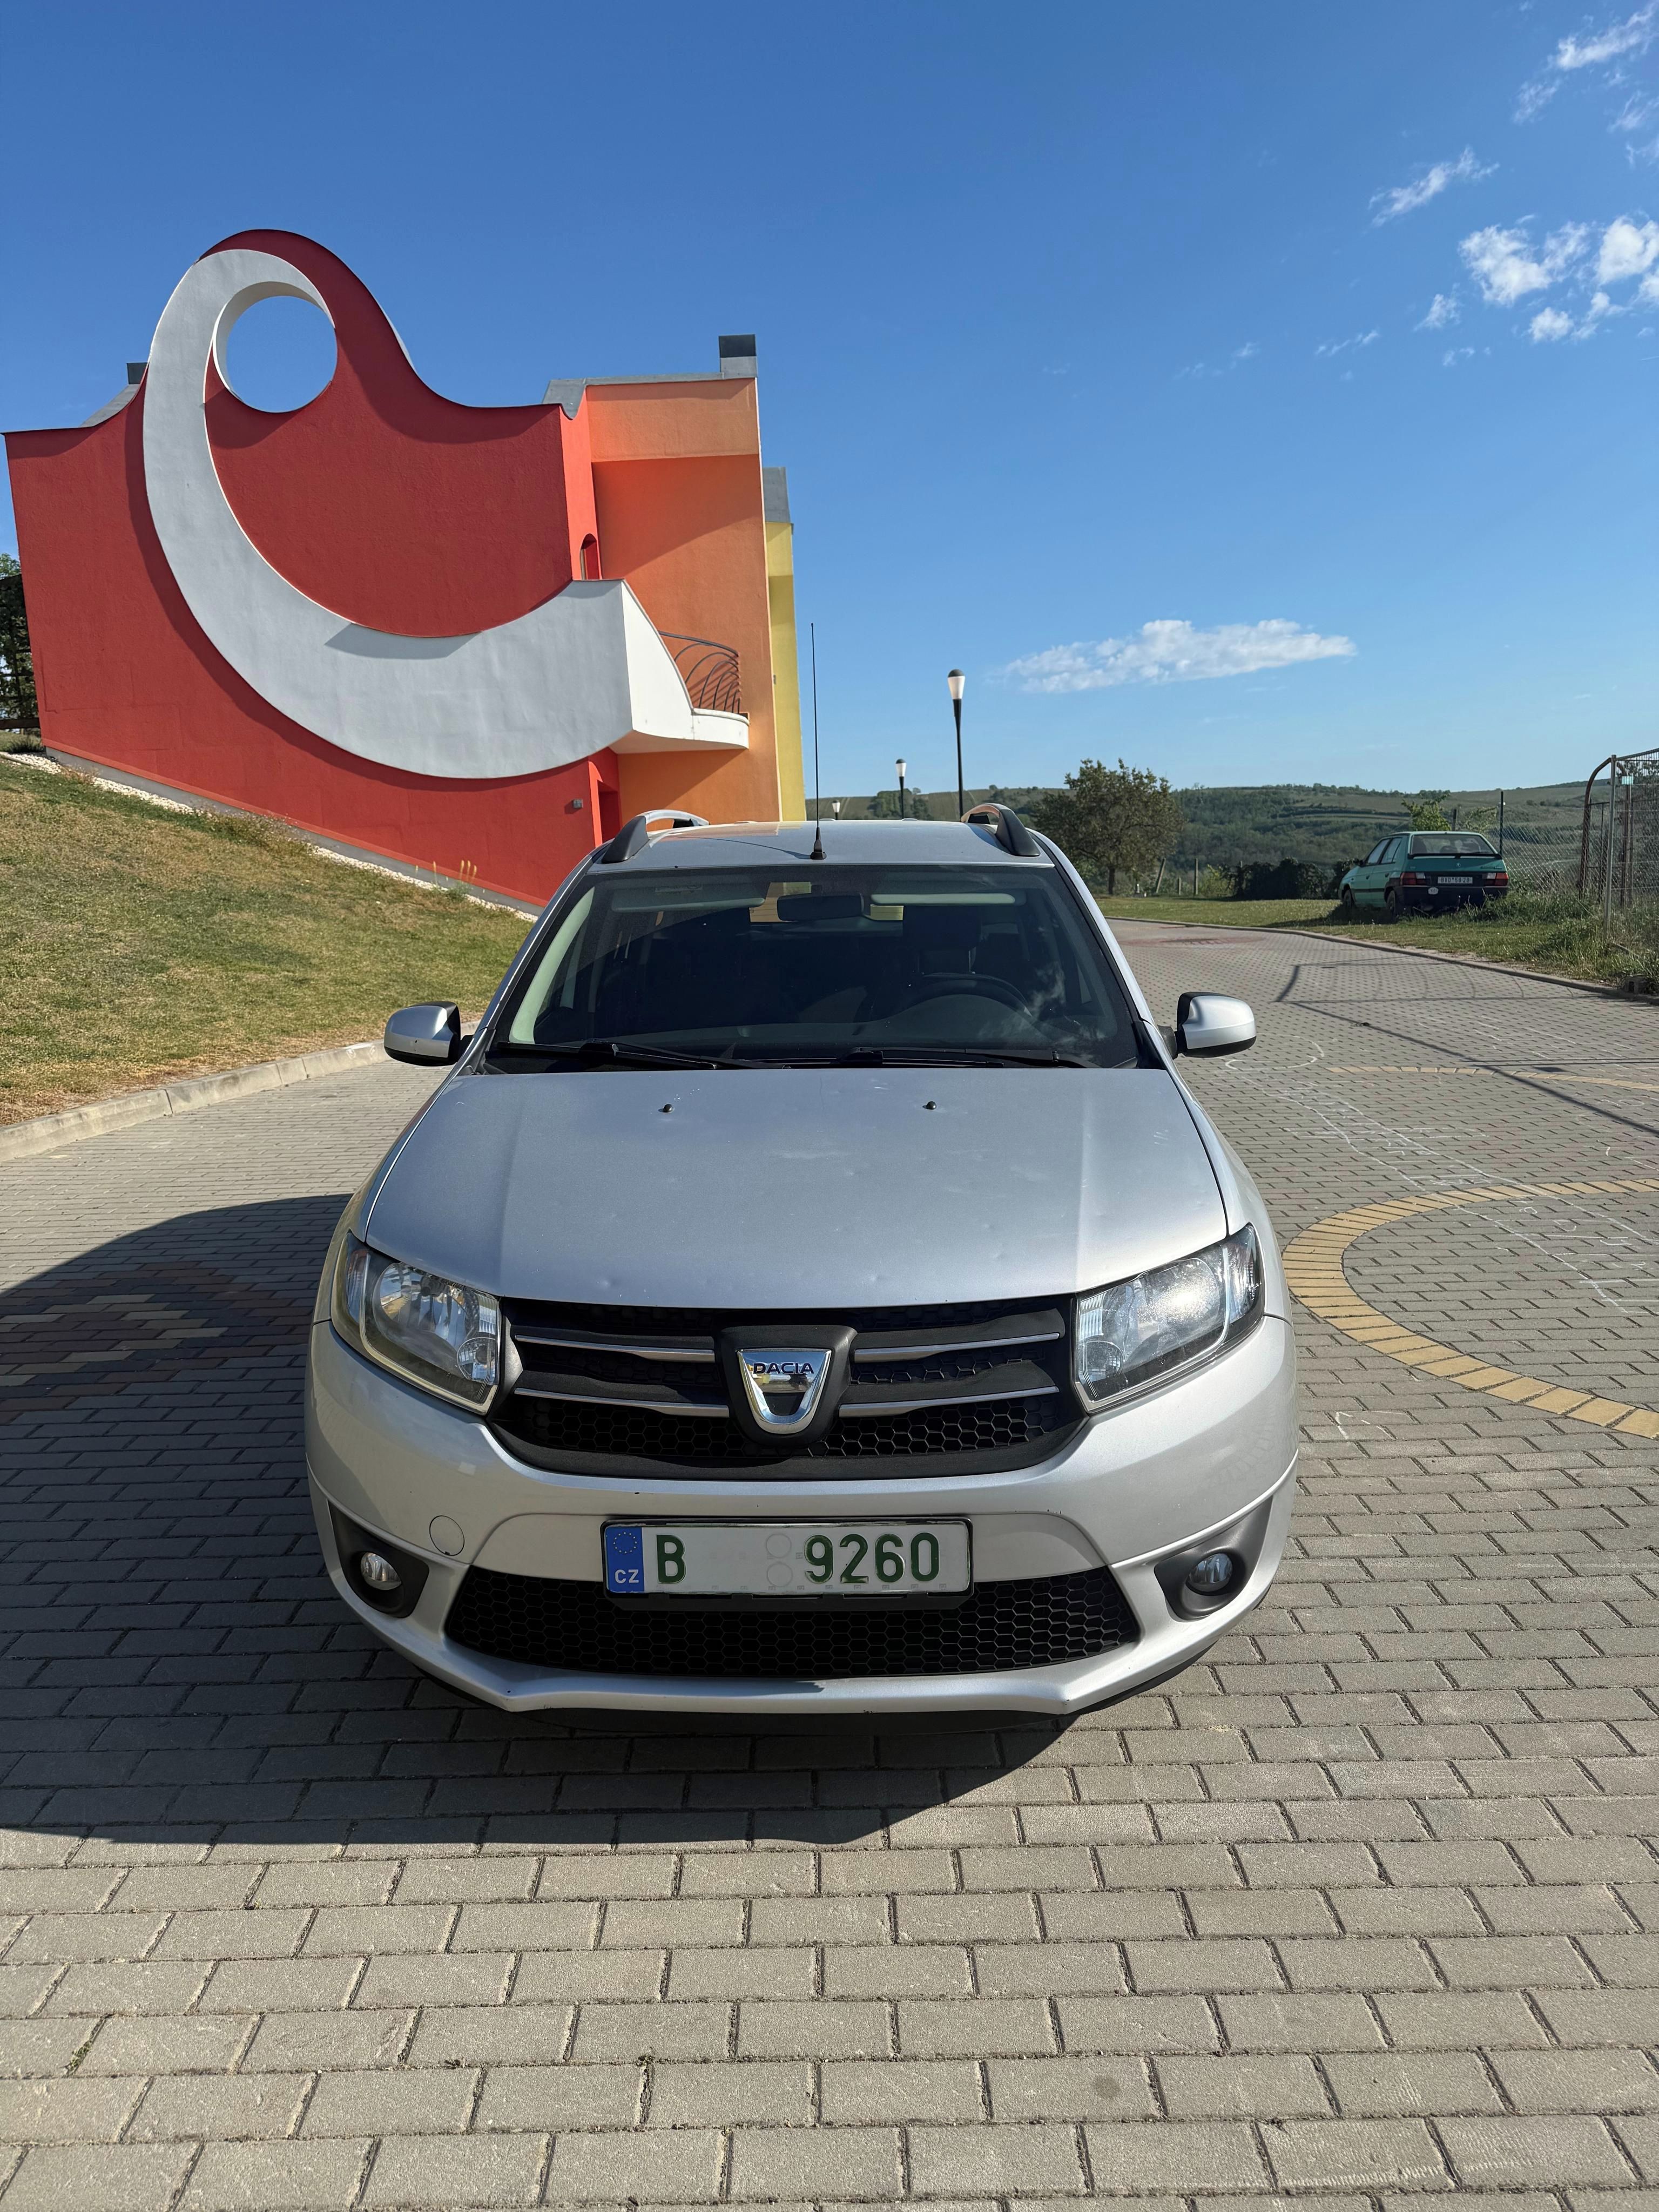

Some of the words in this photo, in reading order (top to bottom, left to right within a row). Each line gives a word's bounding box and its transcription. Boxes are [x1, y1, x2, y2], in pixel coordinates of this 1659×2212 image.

[753, 1363, 814, 1374] DACIA
[656, 1534, 686, 1584] B
[804, 1532, 939, 1584] 9260
[615, 1569, 639, 1584] CZ
